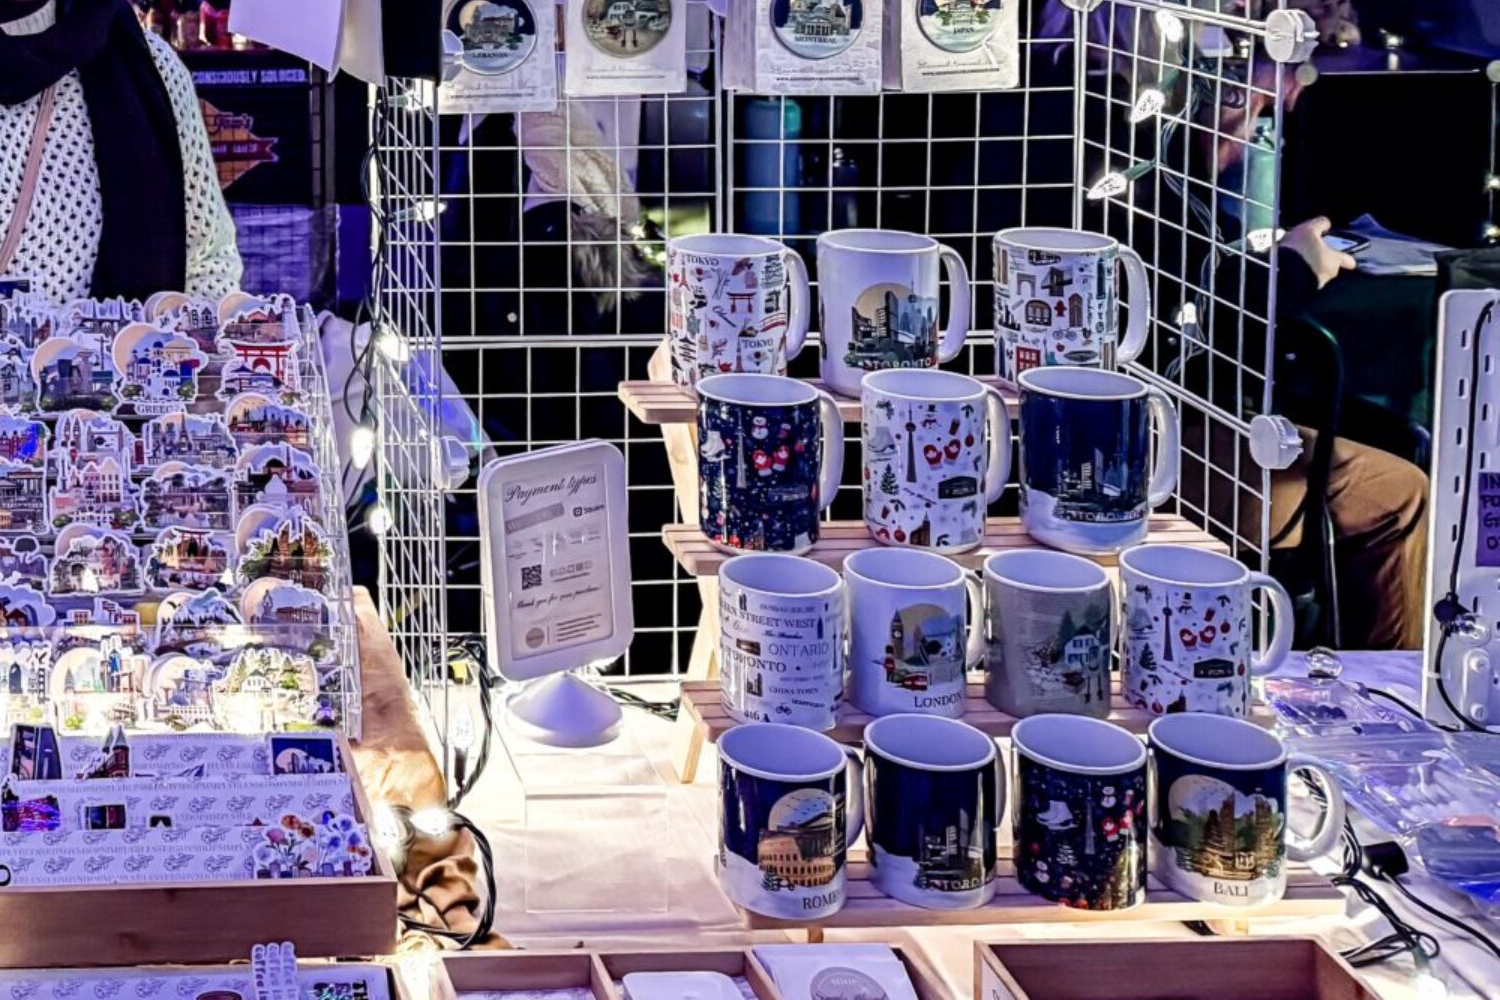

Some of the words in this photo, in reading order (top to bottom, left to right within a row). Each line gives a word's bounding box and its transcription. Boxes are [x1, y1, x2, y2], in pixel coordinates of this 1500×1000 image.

[794, 35, 838, 44] MONTREAL
[686, 253, 720, 266] TOKYO
[743, 339, 774, 349] TOKYO
[504, 483, 566, 506] Payment
[567, 475, 597, 497] types
[739, 612, 780, 628] STREET
[783, 618, 816, 629] WEST
[768, 642, 829, 657] ONTARIO
[726, 646, 787, 673] TORONTO
[913, 690, 964, 709] LONDON
[1213, 881, 1249, 898] BALI
